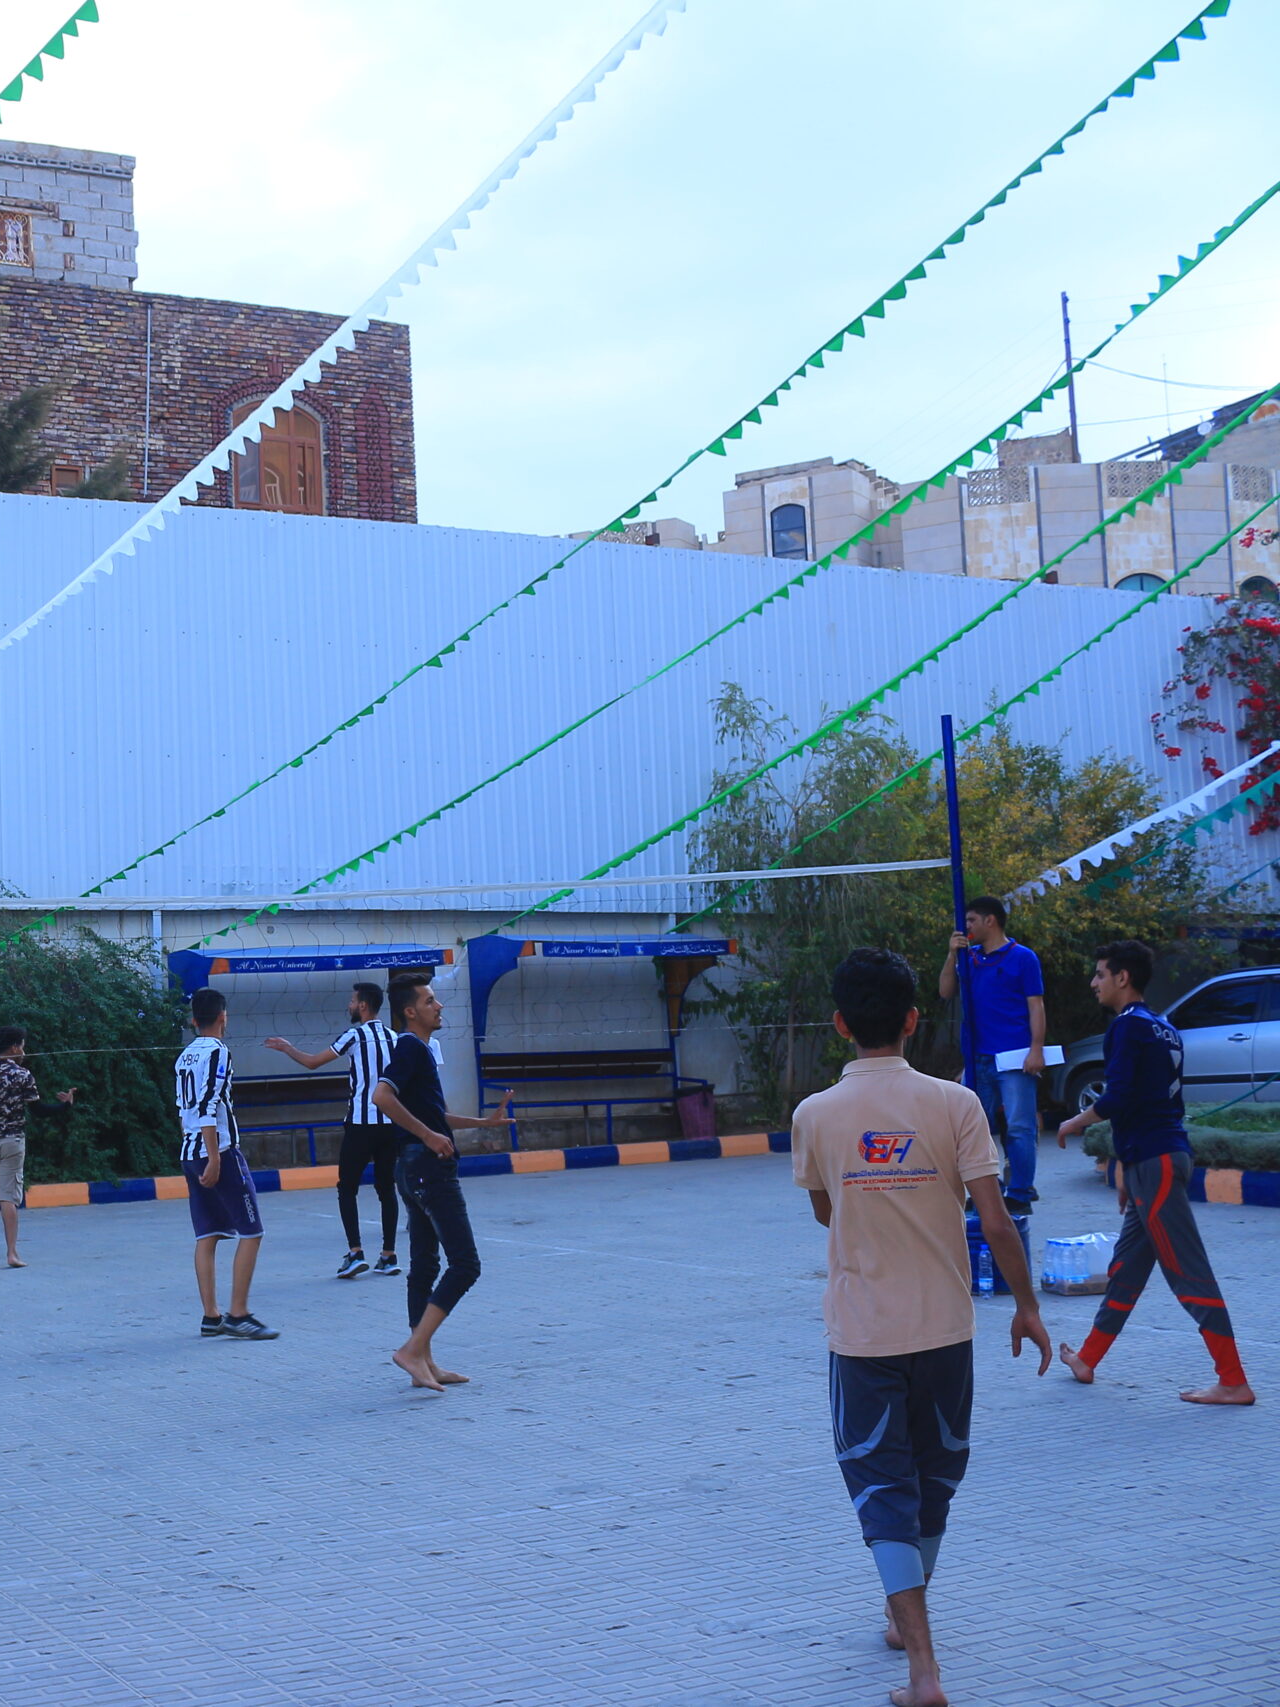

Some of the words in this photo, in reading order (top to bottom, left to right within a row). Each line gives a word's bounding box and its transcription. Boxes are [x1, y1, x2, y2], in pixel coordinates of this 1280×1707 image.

[278, 960, 316, 972] University
[179, 1069, 197, 1110] 10
[244, 1198, 257, 1224] adidas
